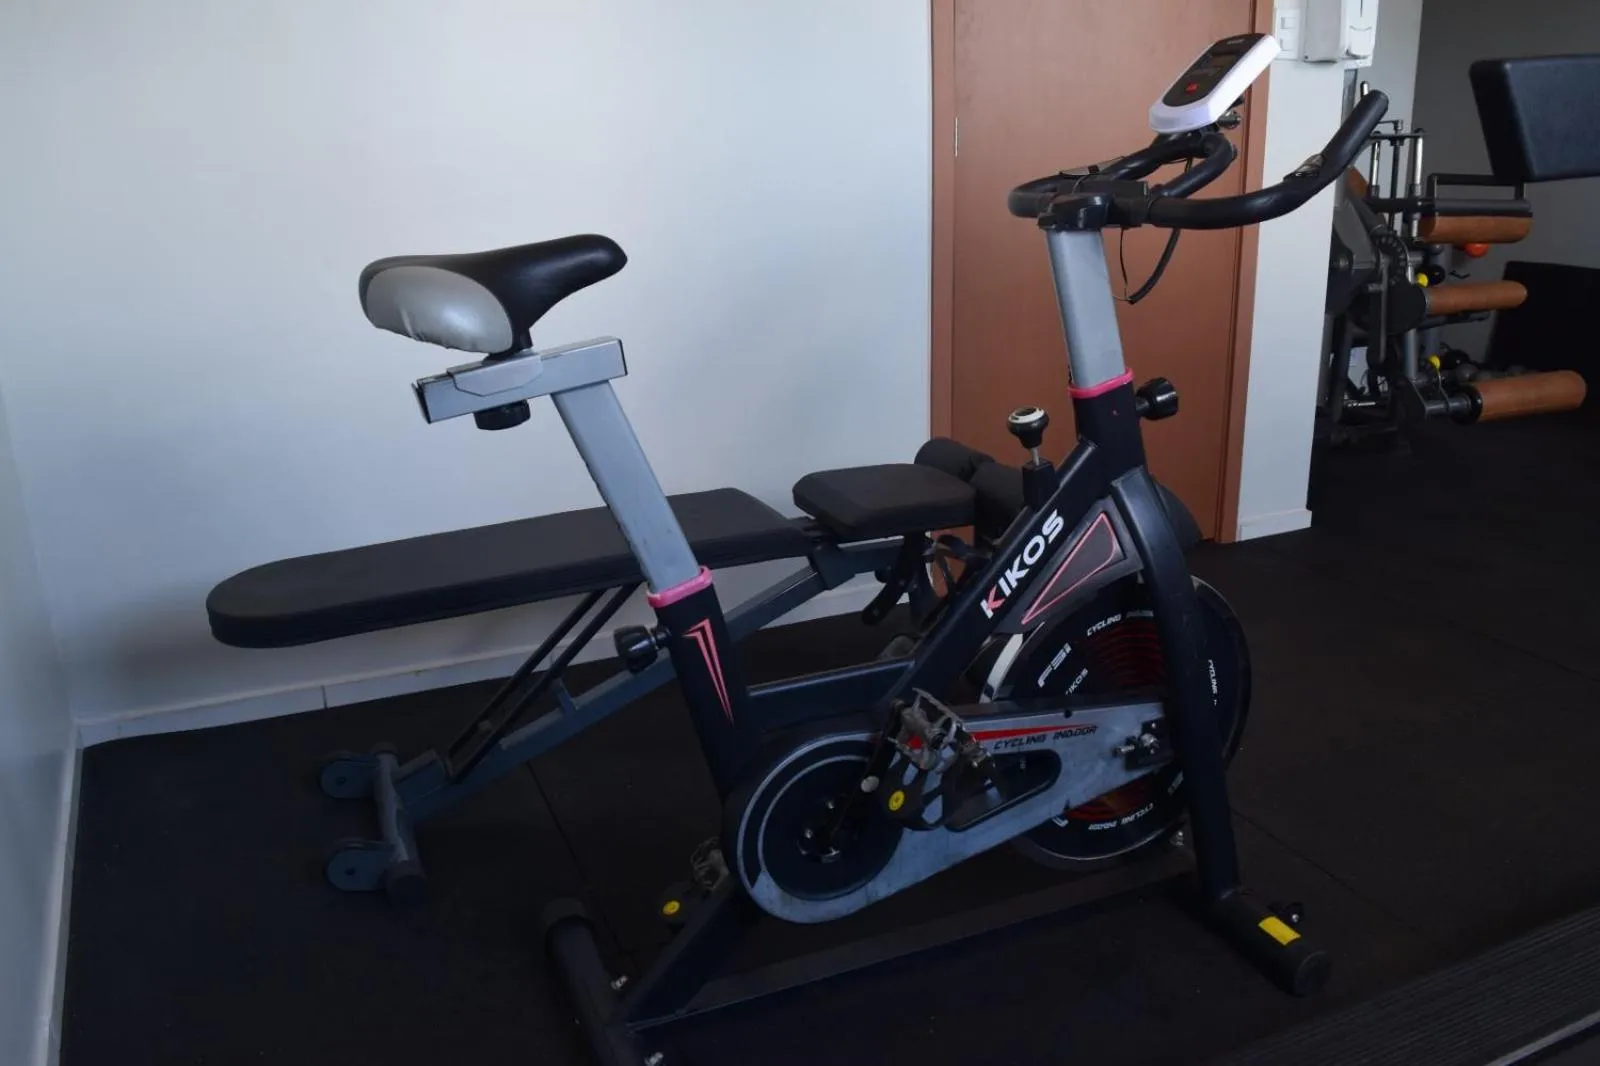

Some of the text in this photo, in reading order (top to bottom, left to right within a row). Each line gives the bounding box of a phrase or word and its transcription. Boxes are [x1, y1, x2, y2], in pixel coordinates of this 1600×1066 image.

[980, 508, 1064, 619] KIKOS
[1086, 613, 1122, 637] CYCLING
[993, 733, 1047, 750] CYCLING
